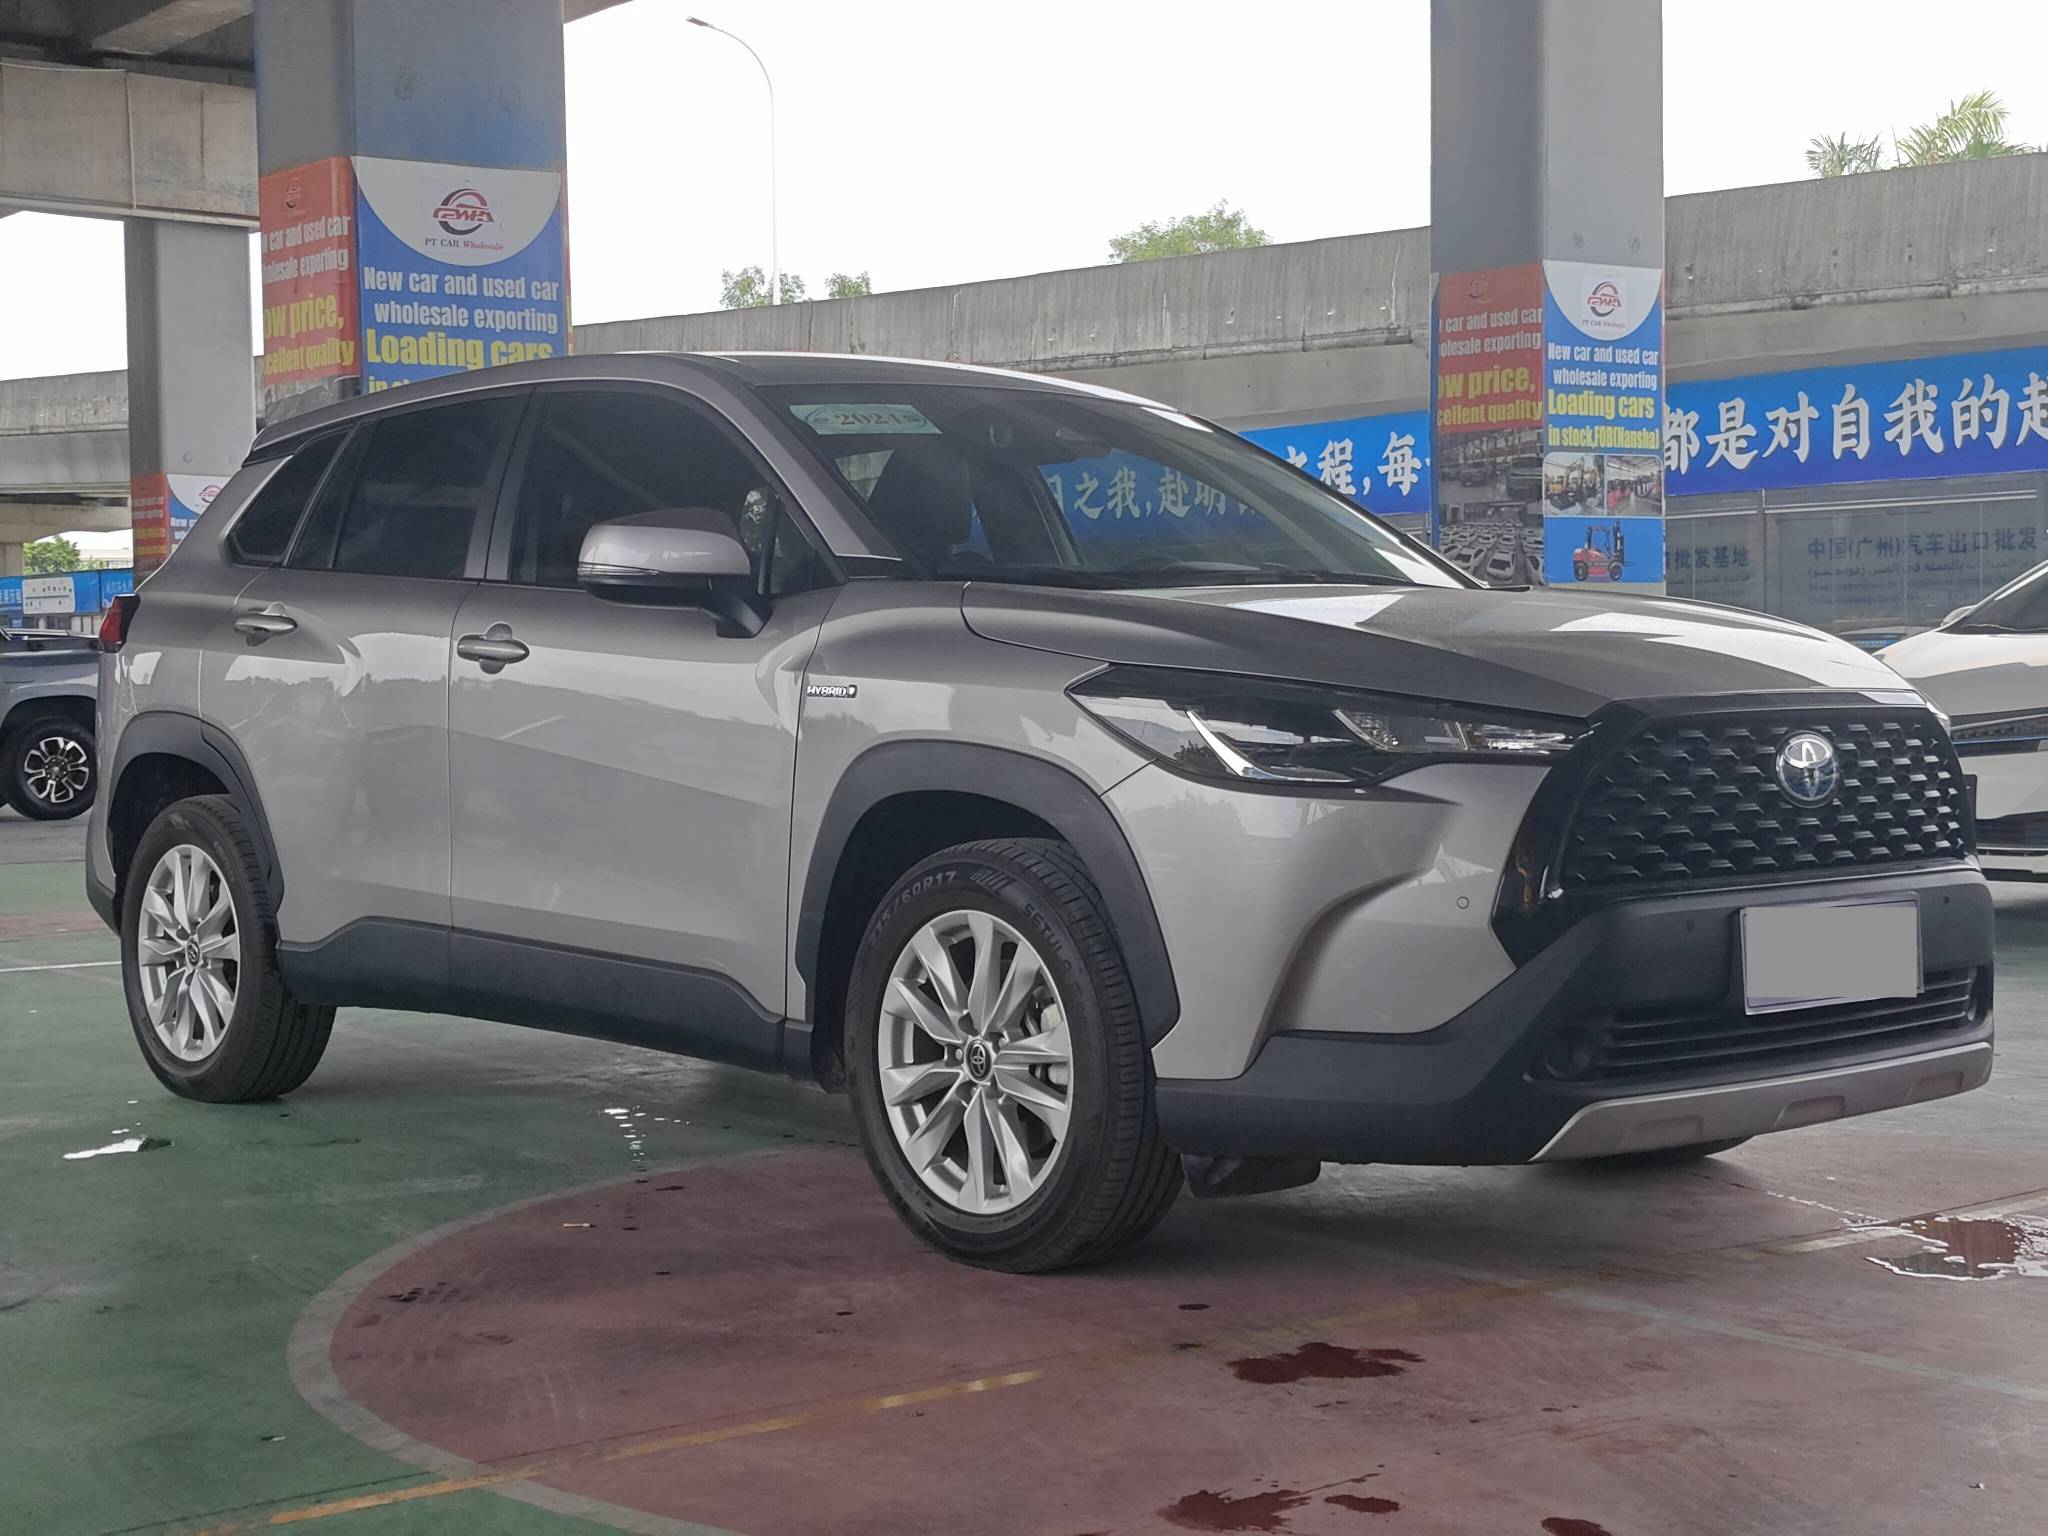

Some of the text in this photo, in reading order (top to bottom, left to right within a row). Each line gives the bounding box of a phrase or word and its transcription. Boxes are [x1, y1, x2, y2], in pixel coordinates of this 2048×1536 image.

[327, 215, 351, 237] car
[440, 239, 460, 248] CAR
[364, 267, 559, 302] New car and used car
[374, 301, 559, 334] wholesale exporting
[1445, 316, 1465, 333] car
[1466, 312, 1487, 331] and
[1490, 308, 1518, 328] used
[1521, 308, 1544, 324] car
[366, 328, 484, 371] Loading
[1484, 331, 1541, 354] exporting
[1548, 342, 1659, 366] New car and used car
[1468, 364, 1536, 400] price,
[1553, 367, 1657, 391] wholesale exporting
[1488, 399, 1543, 423] quality
[1547, 388, 1655, 420] Loading cars
[1548, 424, 1560, 446] in
[806, 685, 848, 697] HYBRID
